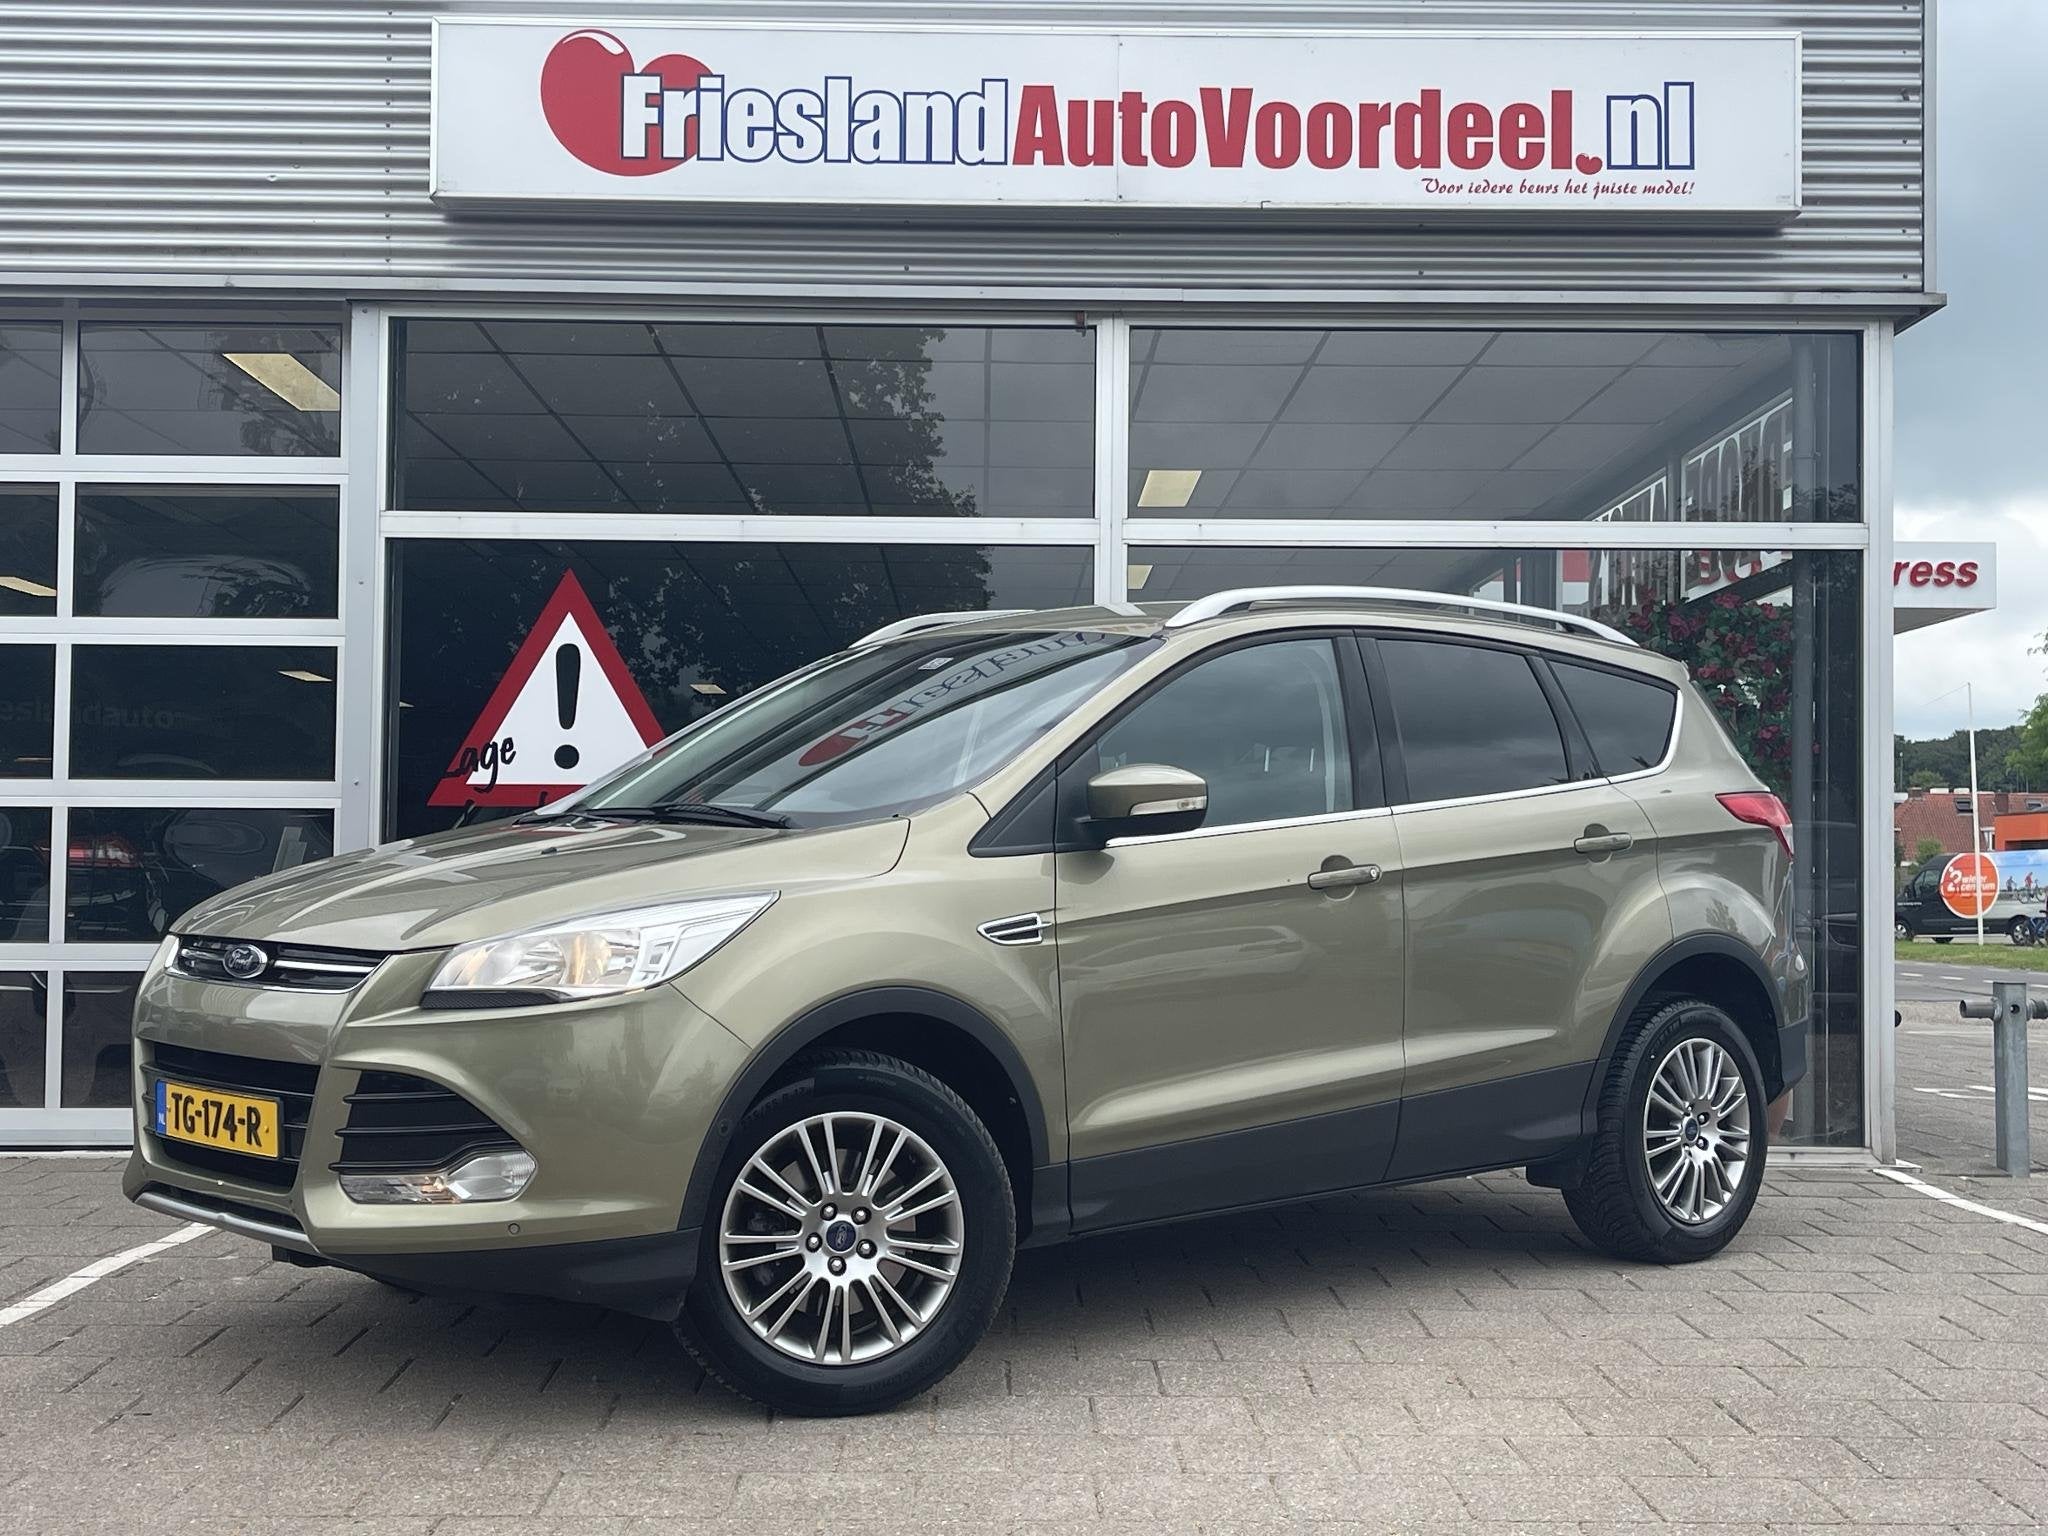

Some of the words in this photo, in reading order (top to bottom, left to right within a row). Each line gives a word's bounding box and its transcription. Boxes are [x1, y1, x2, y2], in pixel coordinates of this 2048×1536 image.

[1420, 177, 1463, 195] Voor
[1467, 179, 1514, 195] iedere
[1518, 177, 1559, 195] beurs
[1563, 178, 1588, 195] het
[1592, 180, 1638, 200] juiste
[1641, 179, 1696, 195] model!
[1960, 882, 1996, 892] cenum
[229, 948, 254, 970] Ford
[170, 1091, 263, 1149] TG-174-R
